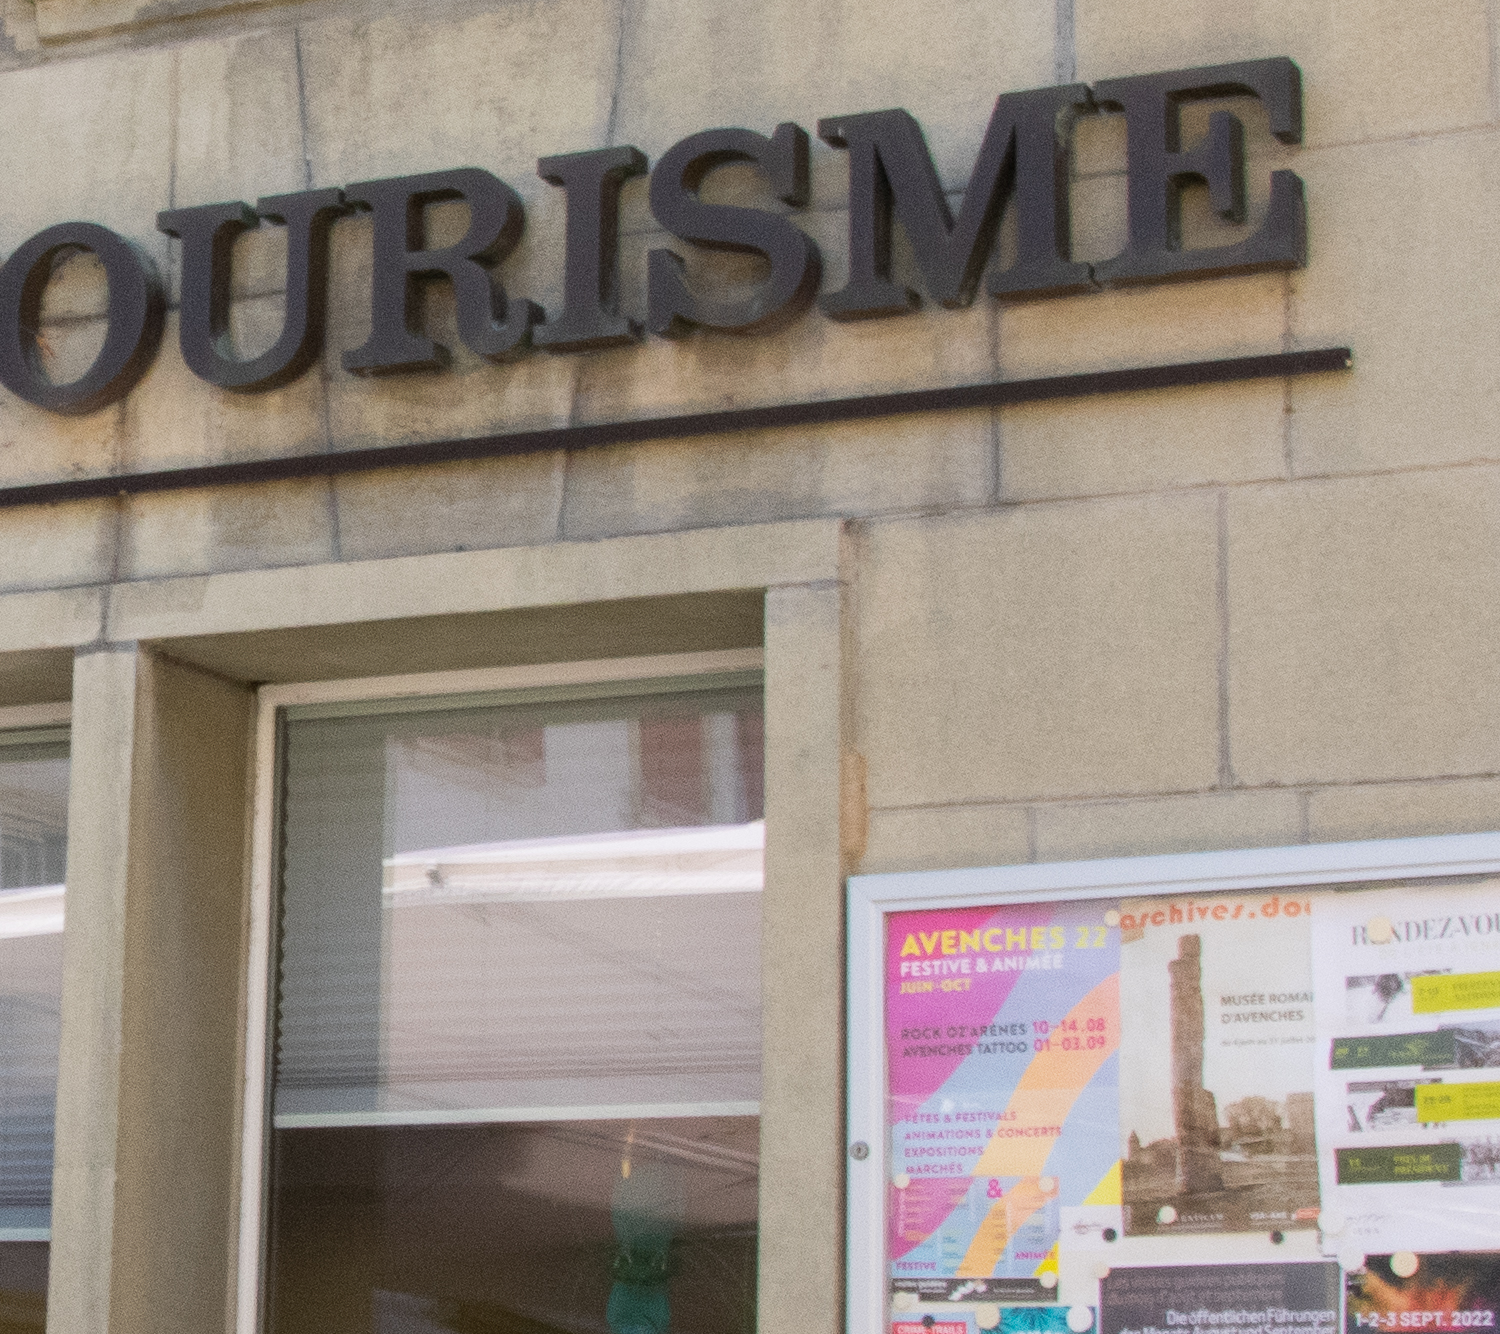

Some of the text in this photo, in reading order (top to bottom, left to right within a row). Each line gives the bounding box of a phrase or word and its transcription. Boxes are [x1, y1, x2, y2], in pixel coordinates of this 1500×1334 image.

[899, 925, 1108, 958] AVENCHES 22
[900, 952, 1064, 977] FESTIVE & ANIMÉE
[1221, 992, 1266, 1007] MUSÉE
[1221, 1010, 1304, 1024] D'AVENCHES
[901, 1027, 942, 1040] ROCK
[902, 1043, 972, 1058] AVENCHES
[977, 1041, 1028, 1054] TATTOO
[955, 1111, 1017, 1123] FESTIVALS
[904, 1129, 981, 1141] ANIMATIONS
[997, 1126, 1062, 1138] CONCERTS
[904, 1146, 984, 1158] EXPOSITIONS
[906, 1163, 963, 1175] MARCHÉS
[986, 1178, 1003, 1199] &
[1166, 1308, 1335, 1326] Die öffentlichen Führungen
[1355, 1310, 1494, 1327] 1-2-3 SEPT. 2022
